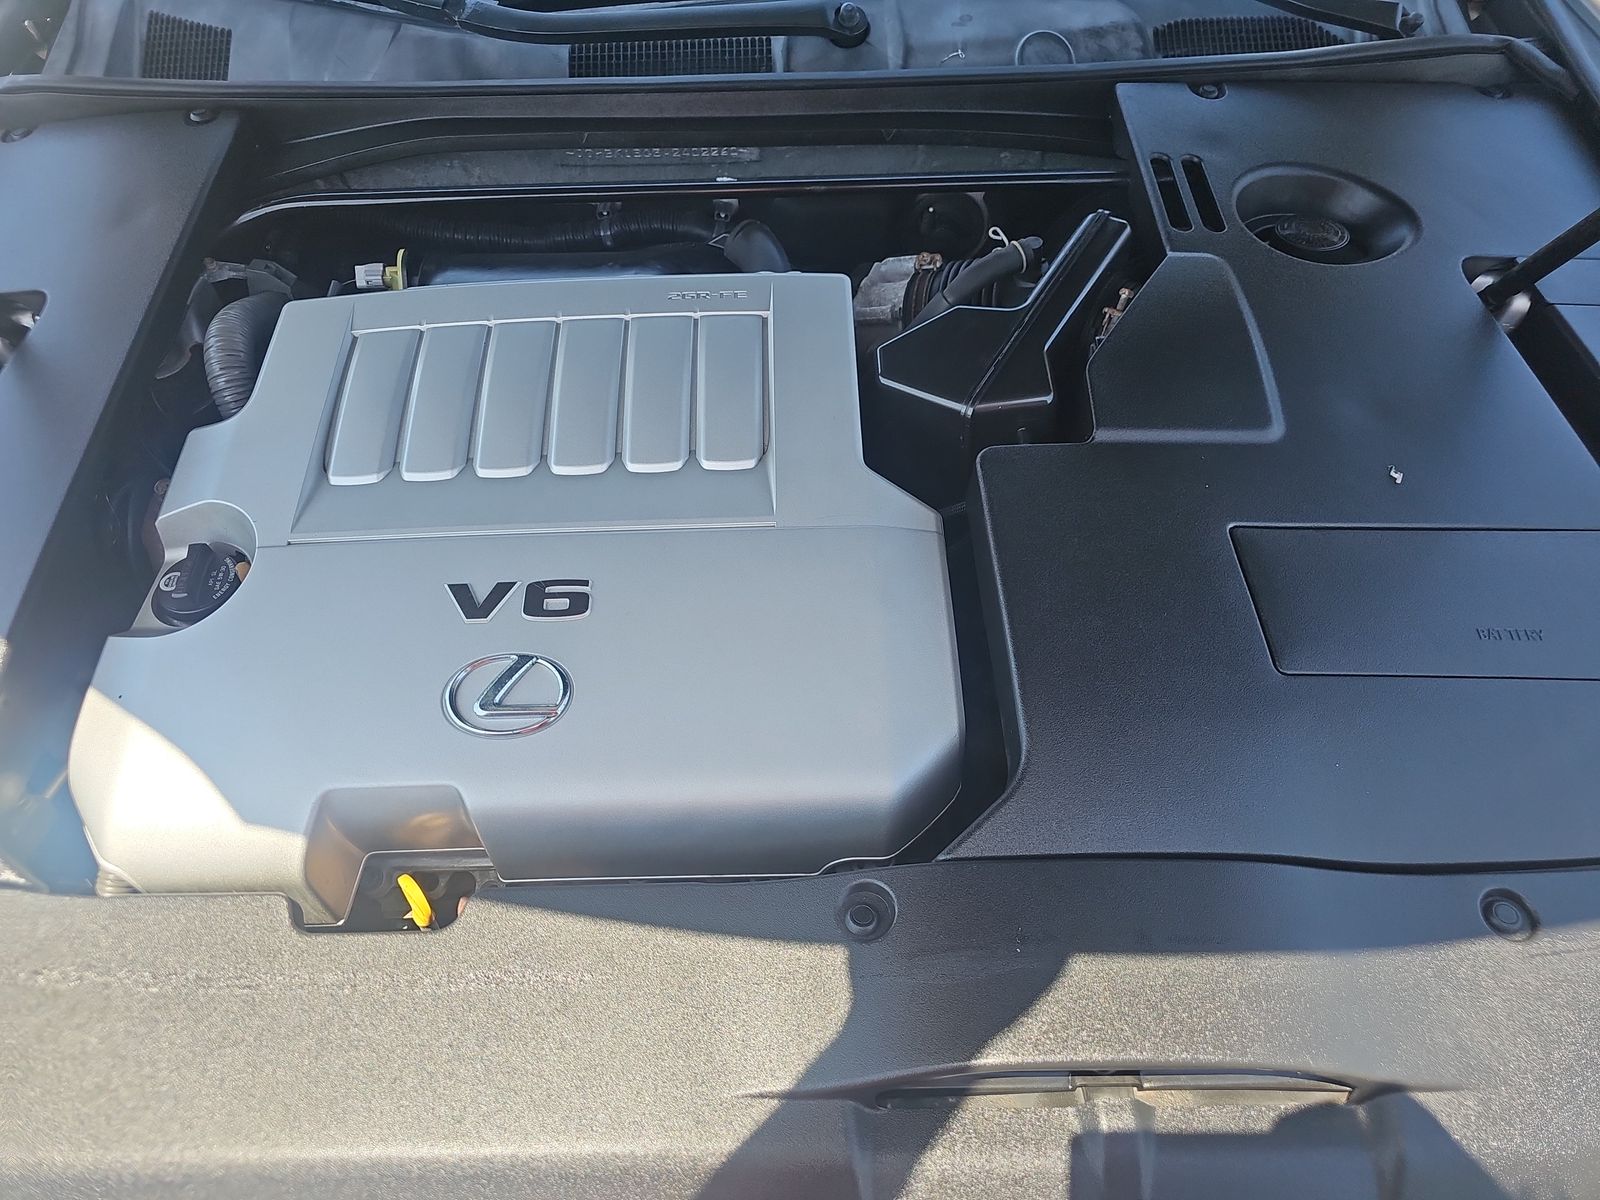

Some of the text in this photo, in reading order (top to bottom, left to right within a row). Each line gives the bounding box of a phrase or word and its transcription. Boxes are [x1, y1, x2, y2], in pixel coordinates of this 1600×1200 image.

[667, 290, 748, 300] 2GR-FE
[212, 583, 230, 600] ENERGY
[444, 579, 593, 624] V6
[1476, 627, 1544, 641] BATTERY
